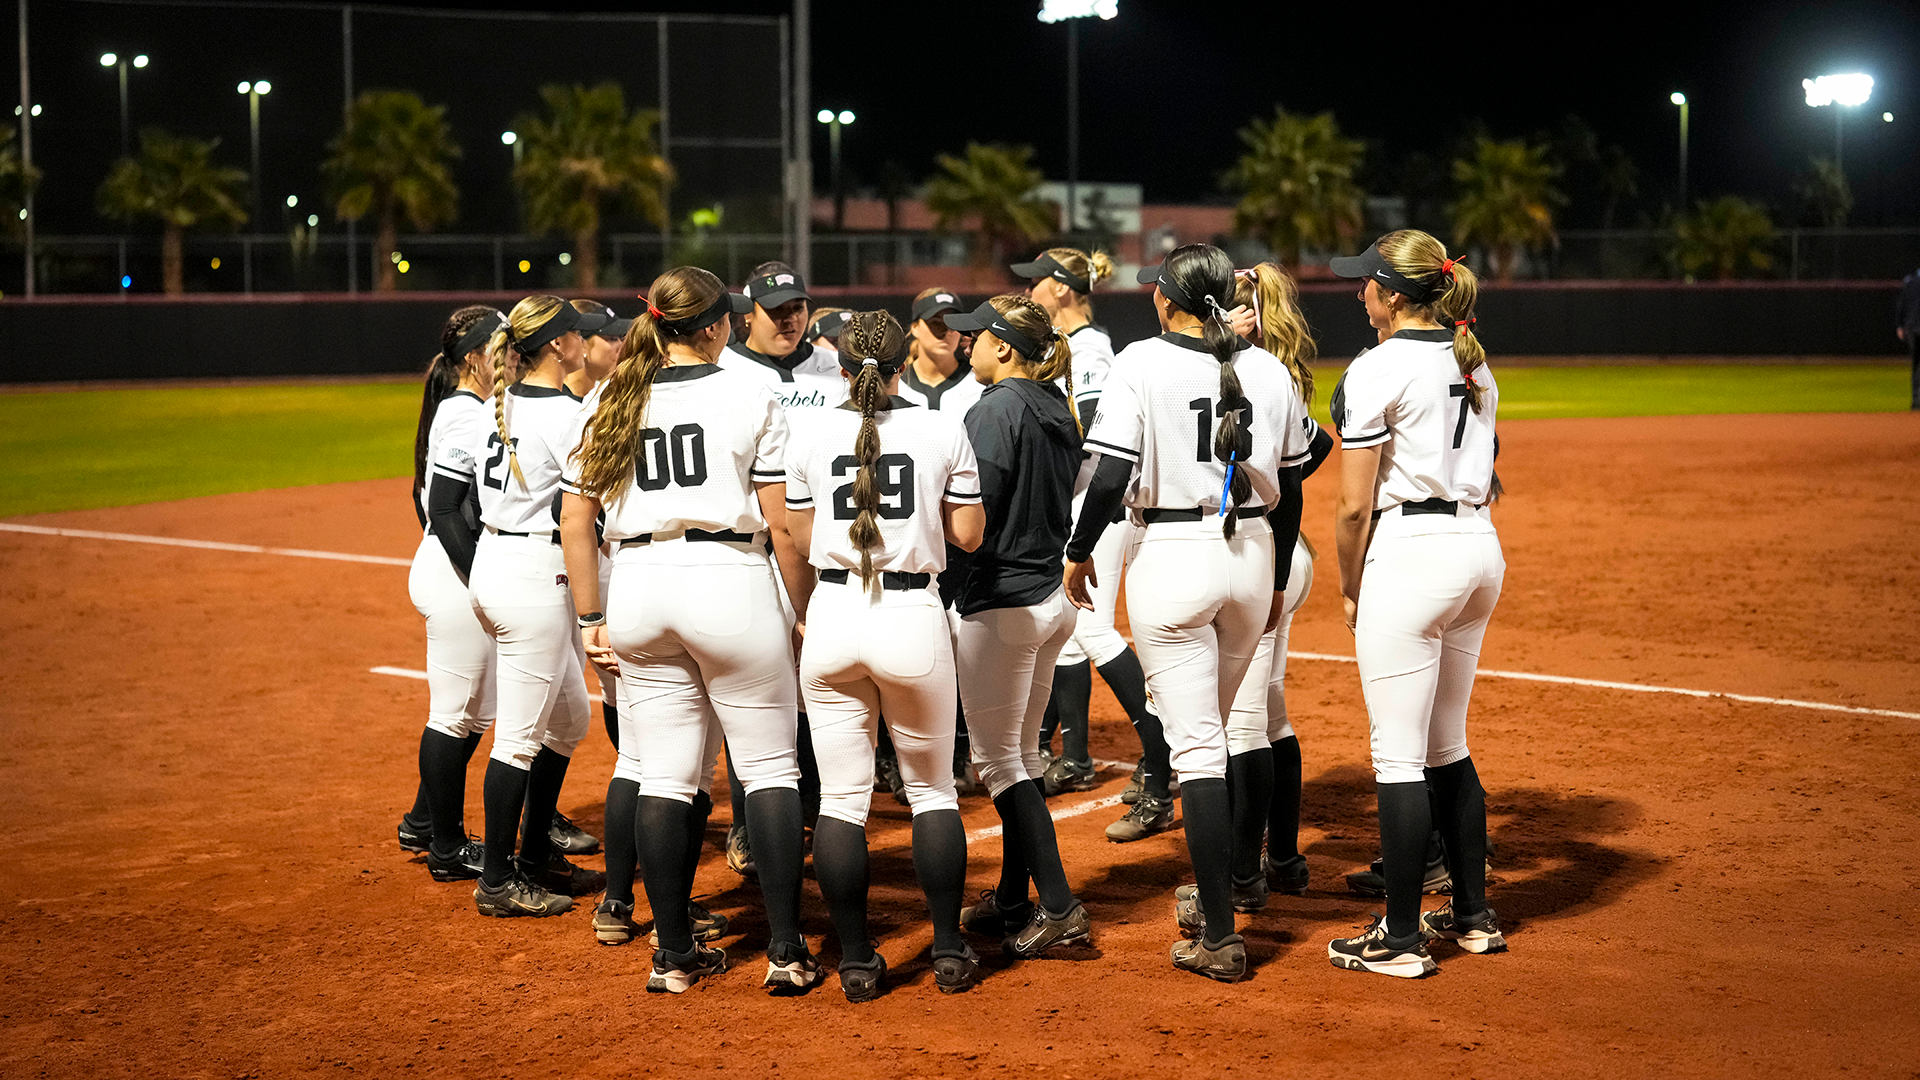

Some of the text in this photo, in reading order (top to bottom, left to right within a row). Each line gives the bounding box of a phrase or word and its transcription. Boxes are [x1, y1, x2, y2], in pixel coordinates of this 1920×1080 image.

[1189, 396, 1253, 462] 13
[1449, 384, 1471, 449] 7
[635, 423, 708, 492] 00
[832, 453, 915, 520] 29
